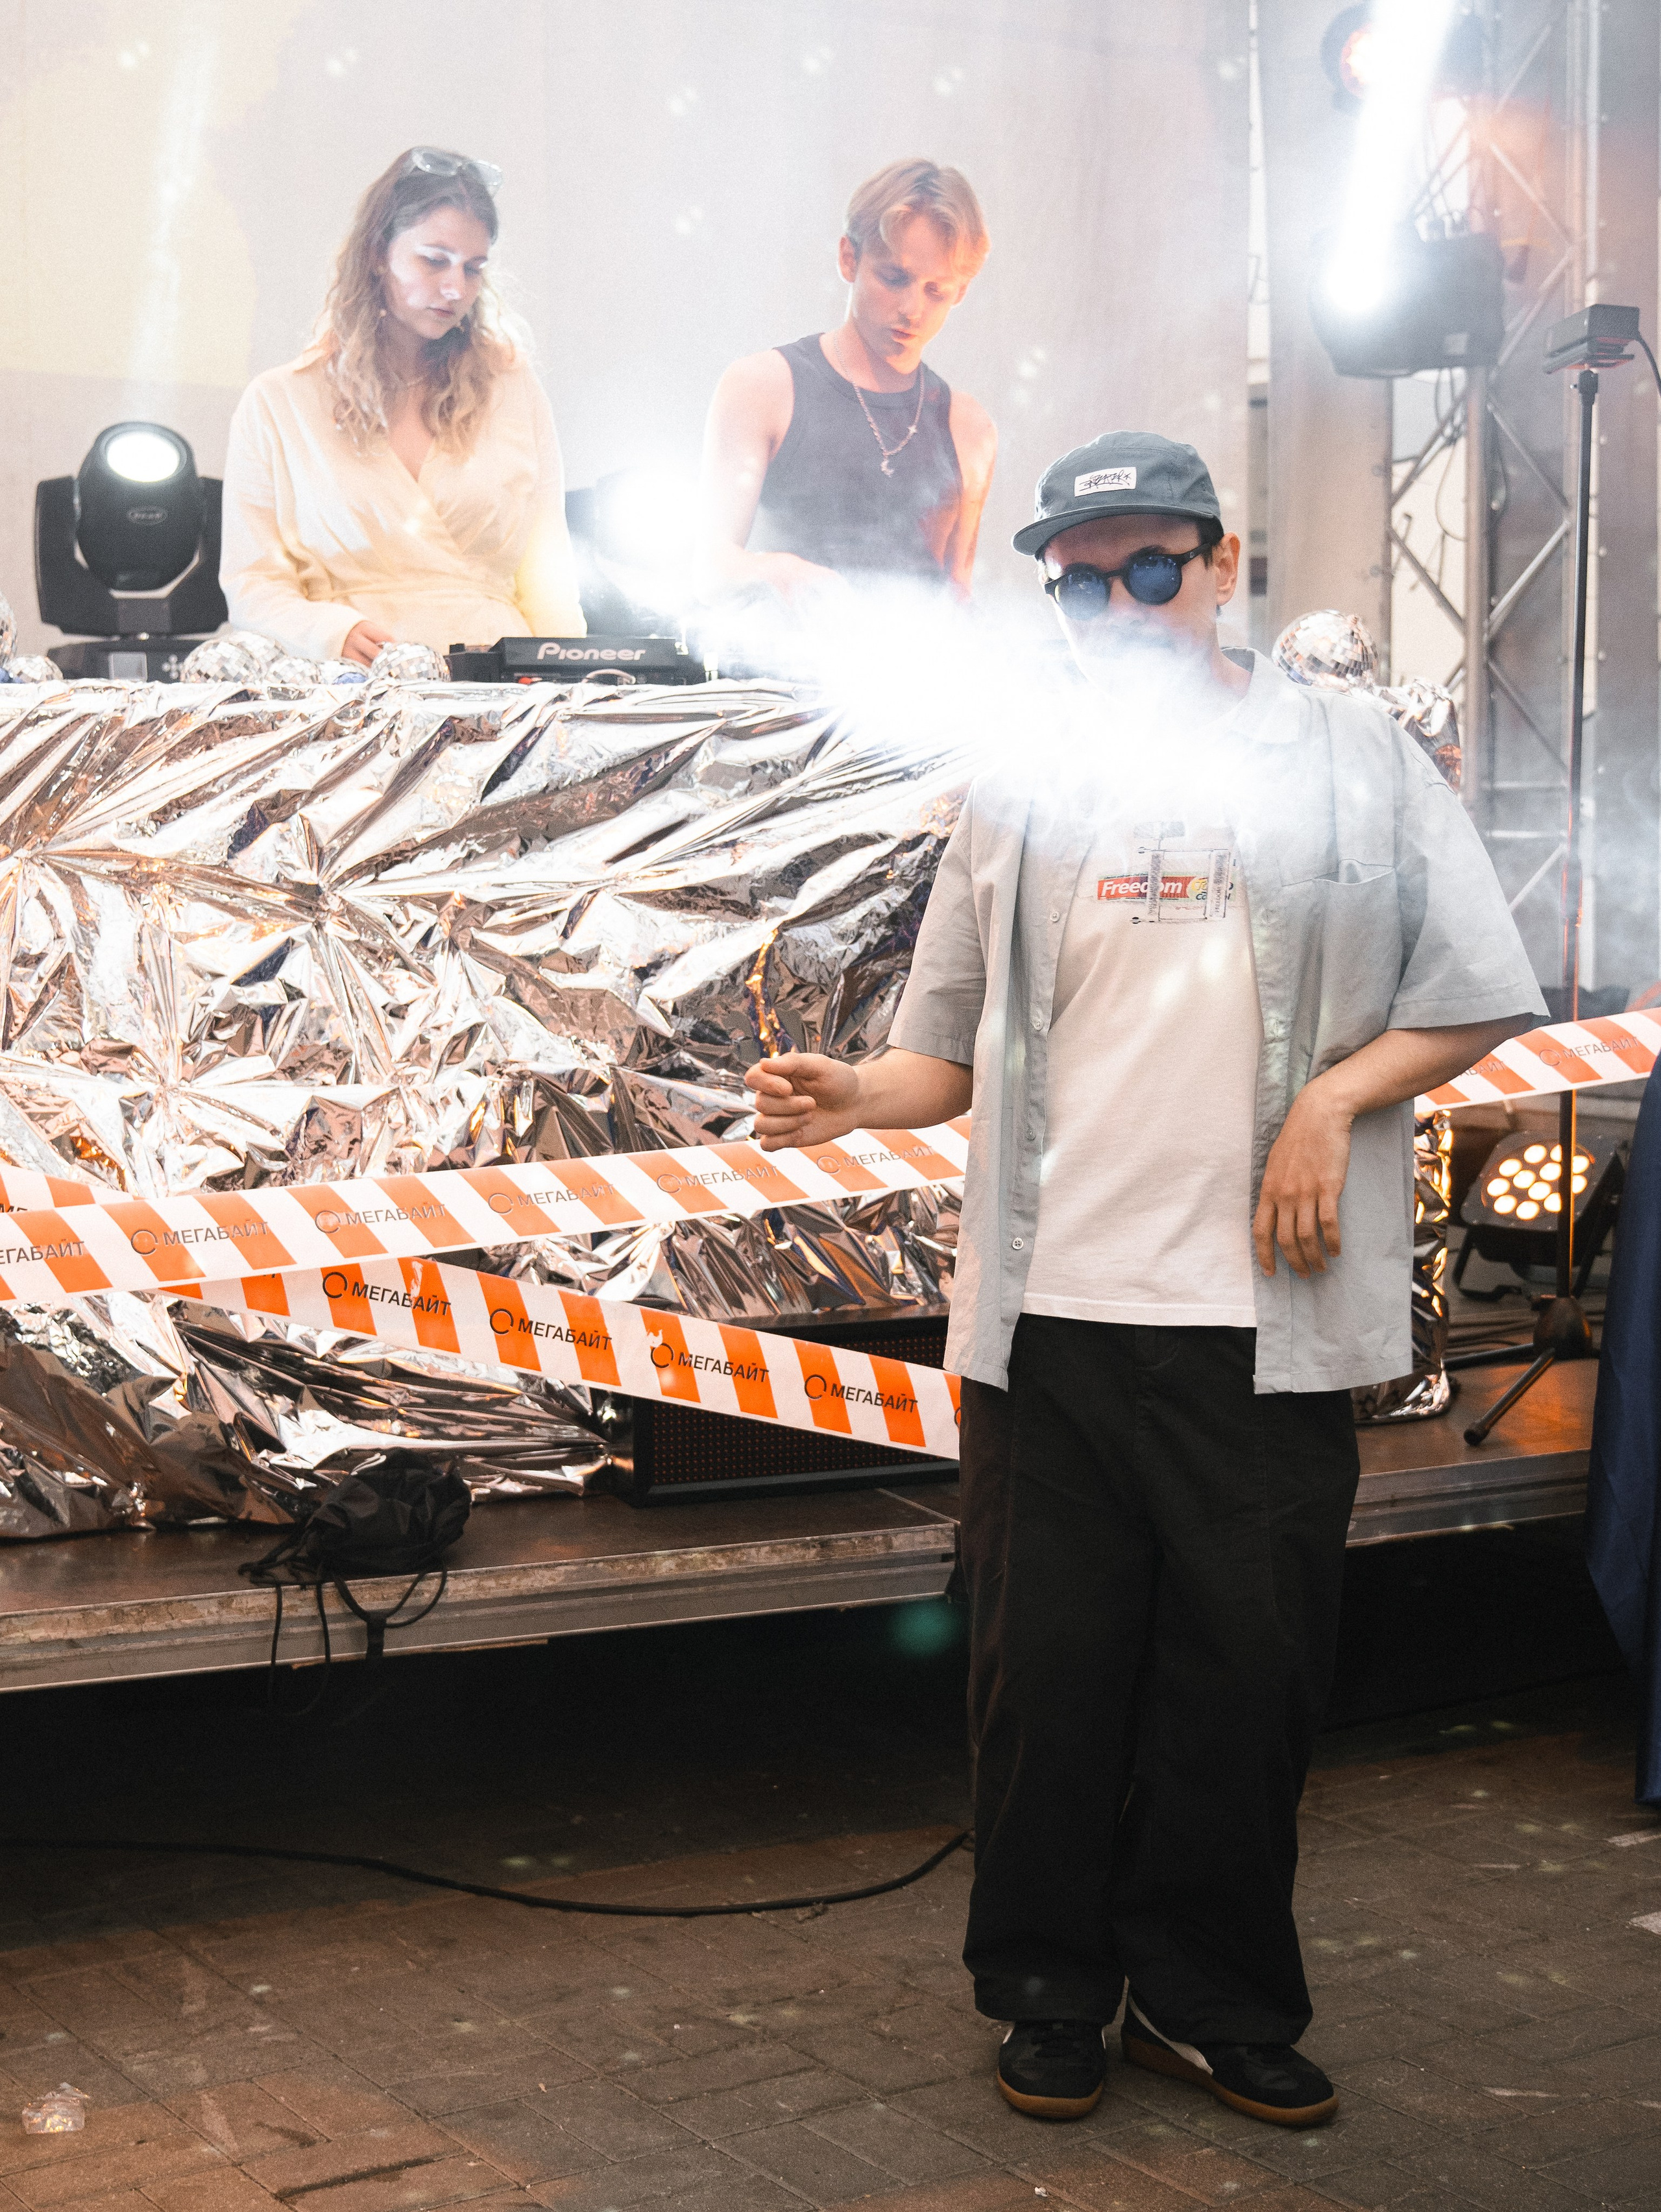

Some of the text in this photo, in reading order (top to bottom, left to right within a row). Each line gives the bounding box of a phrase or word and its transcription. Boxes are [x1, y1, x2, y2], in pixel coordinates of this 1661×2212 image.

[537, 642, 646, 660] Pioneer
[1563, 1037, 1639, 1059] МЕГАБАЙТ
[163, 1220, 268, 1245] МЕГАБАЙТ
[346, 1202, 445, 1226] МЕГАБАЙТ
[517, 1183, 614, 1208] МЕГАБАЙТ
[684, 1165, 777, 1186] МЕГАБАЙТ
[843, 1146, 934, 1168] МЕГАБАЙТ
[352, 1282, 918, 1413] МЕГАБАЙТ МЕГАБАЙТ МЕГАБАЙТ МЕГАБАЙТ
